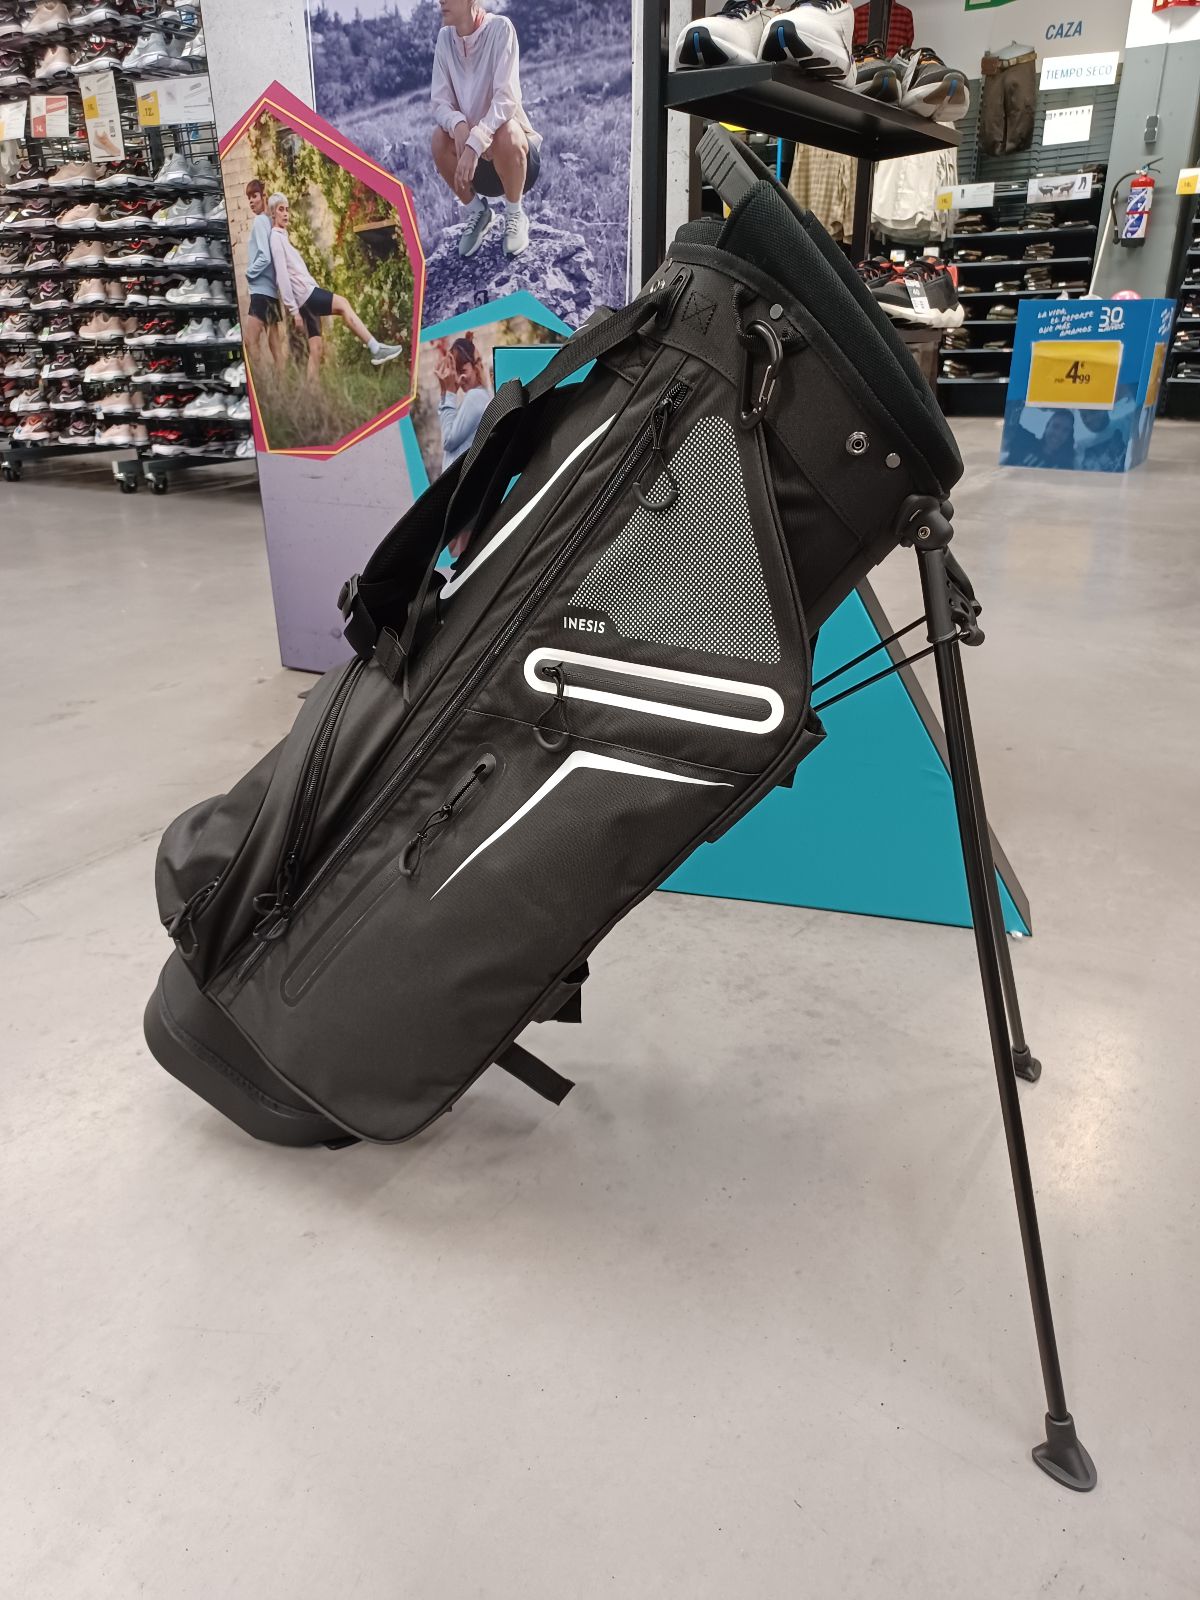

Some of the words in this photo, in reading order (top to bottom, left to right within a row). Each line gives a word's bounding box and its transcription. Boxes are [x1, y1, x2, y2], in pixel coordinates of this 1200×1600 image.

[1045, 20, 1083, 40] CAZA
[1046, 67, 1083, 80] TIEMPO
[1086, 64, 1113, 77] SECO
[1037, 311, 1047, 319] LA
[1050, 317, 1060, 325] EL
[1061, 310, 1095, 323] DEPORTE
[1099, 306, 1124, 327] 30
[1038, 325, 1054, 335] QUE
[1059, 325, 1093, 337] AMAMOS
[563, 616, 606, 634] INESIS
